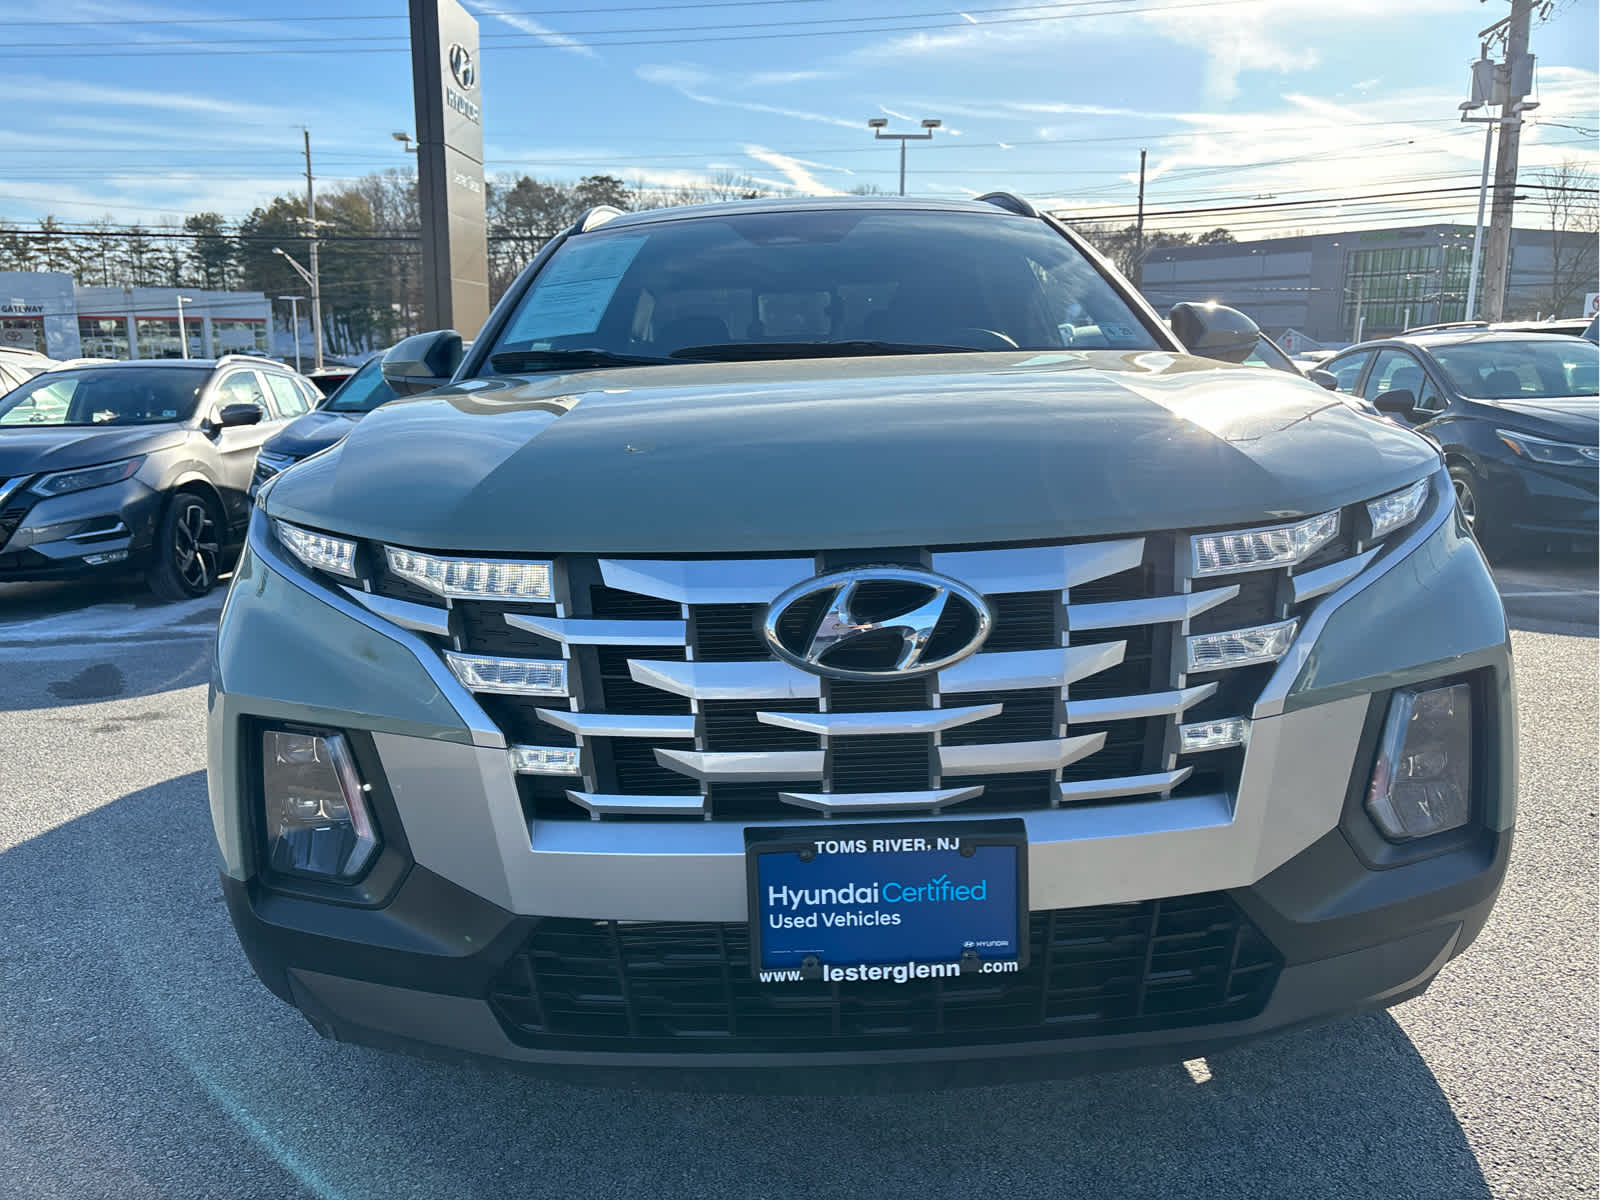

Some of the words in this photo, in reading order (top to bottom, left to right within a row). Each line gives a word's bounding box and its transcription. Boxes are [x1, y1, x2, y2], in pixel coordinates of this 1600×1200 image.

[814, 840, 867, 854] TOMS
[872, 838, 932, 853] RIVER,
[937, 837, 960, 850] NJ
[768, 882, 879, 910] Hyundai
[882, 874, 987, 903] Certified
[769, 912, 818, 928] Used
[821, 910, 902, 928] Vehicles
[759, 970, 804, 982] www.
[823, 961, 960, 983] lesterglenn
[978, 961, 1018, 974] .com
